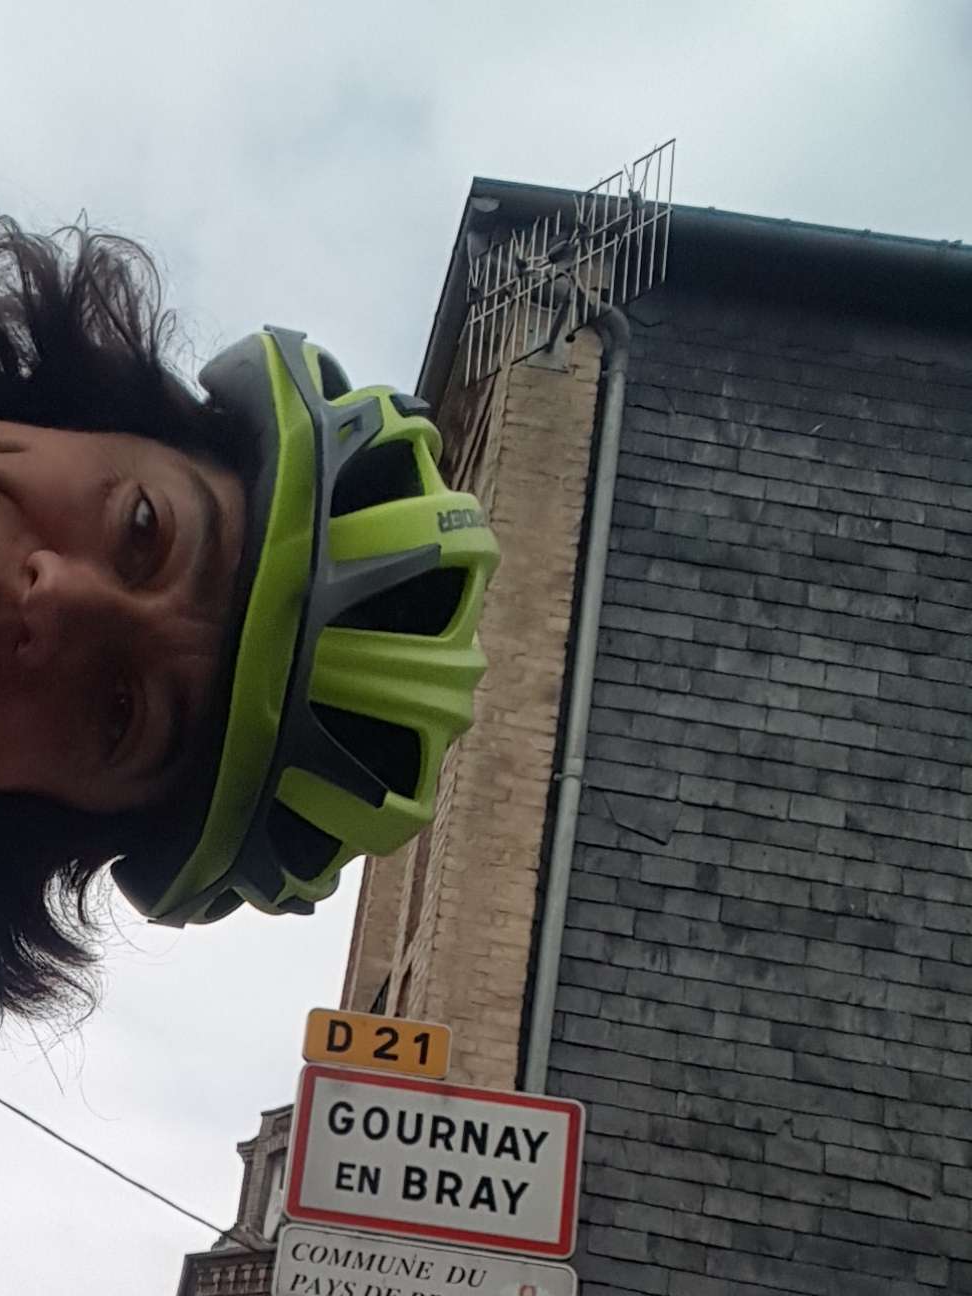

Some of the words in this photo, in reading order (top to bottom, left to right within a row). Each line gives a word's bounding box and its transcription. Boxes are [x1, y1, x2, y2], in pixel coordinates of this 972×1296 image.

[326, 1019, 353, 1053] D
[372, 1027, 431, 1065] 21
[328, 1101, 550, 1164] GOURNAY
[335, 1161, 382, 1195] EN
[402, 1165, 530, 1216] BRAY
[291, 1242, 435, 1281] COMMUNE
[446, 1265, 488, 1288] DU
